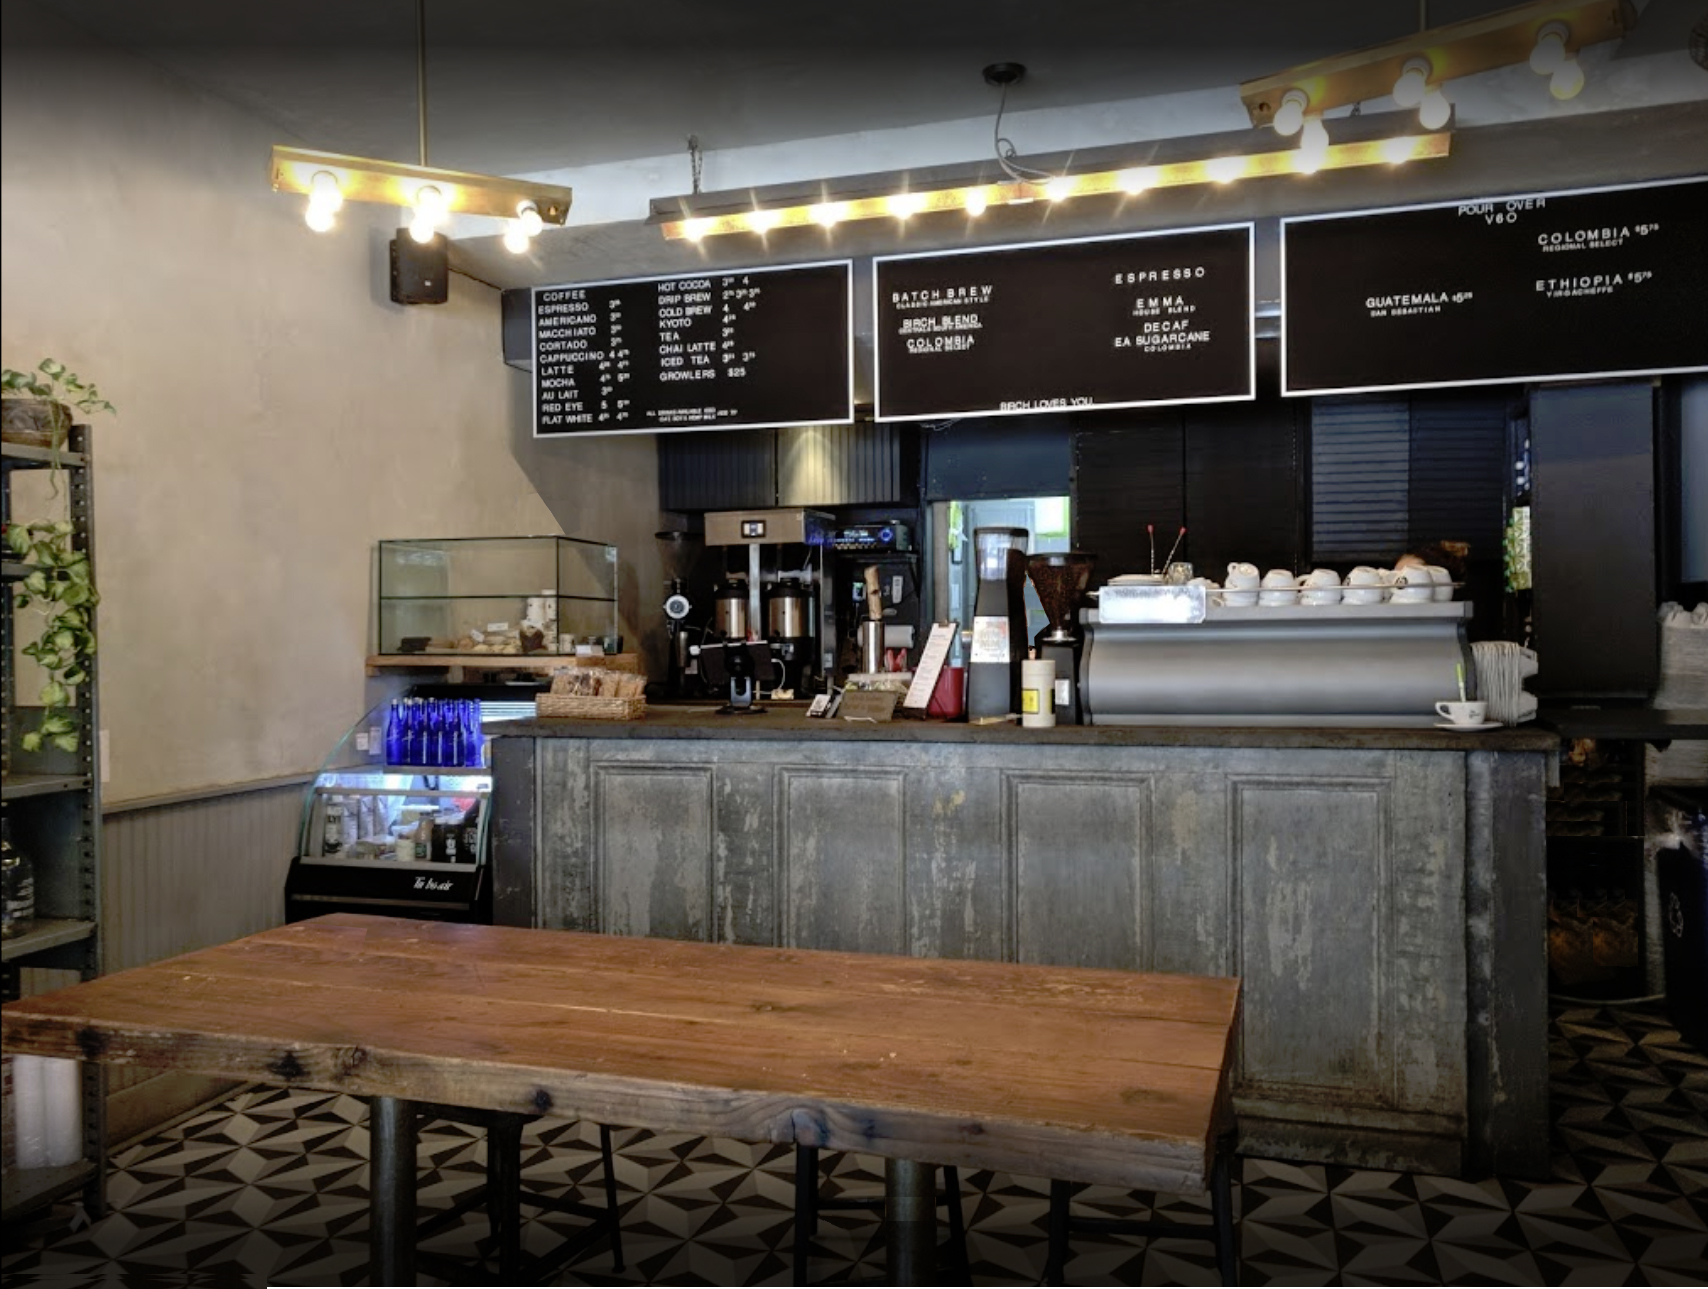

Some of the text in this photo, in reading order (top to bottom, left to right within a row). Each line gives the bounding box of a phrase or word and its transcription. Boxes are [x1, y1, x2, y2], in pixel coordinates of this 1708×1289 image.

[1458, 198, 1546, 216] POUR OVER
[1538, 226, 1630, 245] COLOMBIA
[1542, 238, 1624, 252] REGIONAL SELECT
[1115, 266, 1205, 284] ESPRESSO
[658, 281, 676, 292] HOT
[678, 279, 711, 290] COCOA
[1536, 273, 1623, 291] ETHIOPIA
[543, 290, 587, 301] COFFEE
[658, 294, 681, 305] DRIP
[683, 292, 711, 303] BREW
[892, 285, 993, 303] BATCH BREW
[1365, 291, 1449, 308] GUATEMALA
[538, 302, 589, 314] ESPRESSO
[1136, 295, 1184, 308] EMMA
[658, 307, 683, 318] COLD
[684, 305, 712, 315] BREW
[538, 314, 597, 327] AMERICANO
[659, 318, 692, 329] KYOTO
[903, 314, 979, 328] BIRCH BLEND
[1144, 319, 1189, 333] DECAF
[538, 327, 596, 339] MACCHIATO
[659, 332, 680, 342] TEA
[1115, 330, 1210, 347] EA SUGARCANE
[539, 340, 588, 351] CORTADO
[906, 334, 975, 348] COLOMBIA
[659, 344, 683, 355] CHAI
[687, 341, 716, 352] LATTE
[540, 351, 604, 363] CAPPUCCINO
[661, 357, 684, 368] ICED
[690, 355, 710, 365] TEA
[541, 365, 575, 376] LATTE
[659, 369, 716, 382] GROWLERS
[541, 378, 576, 388] MOCHA
[542, 390, 579, 400] AU LAIT
[1070, 396, 1094, 406] YOU
[542, 402, 561, 413] RED
[565, 402, 583, 411] EYE
[542, 414, 562, 424] FLAT
[565, 413, 593, 424] WHITE
